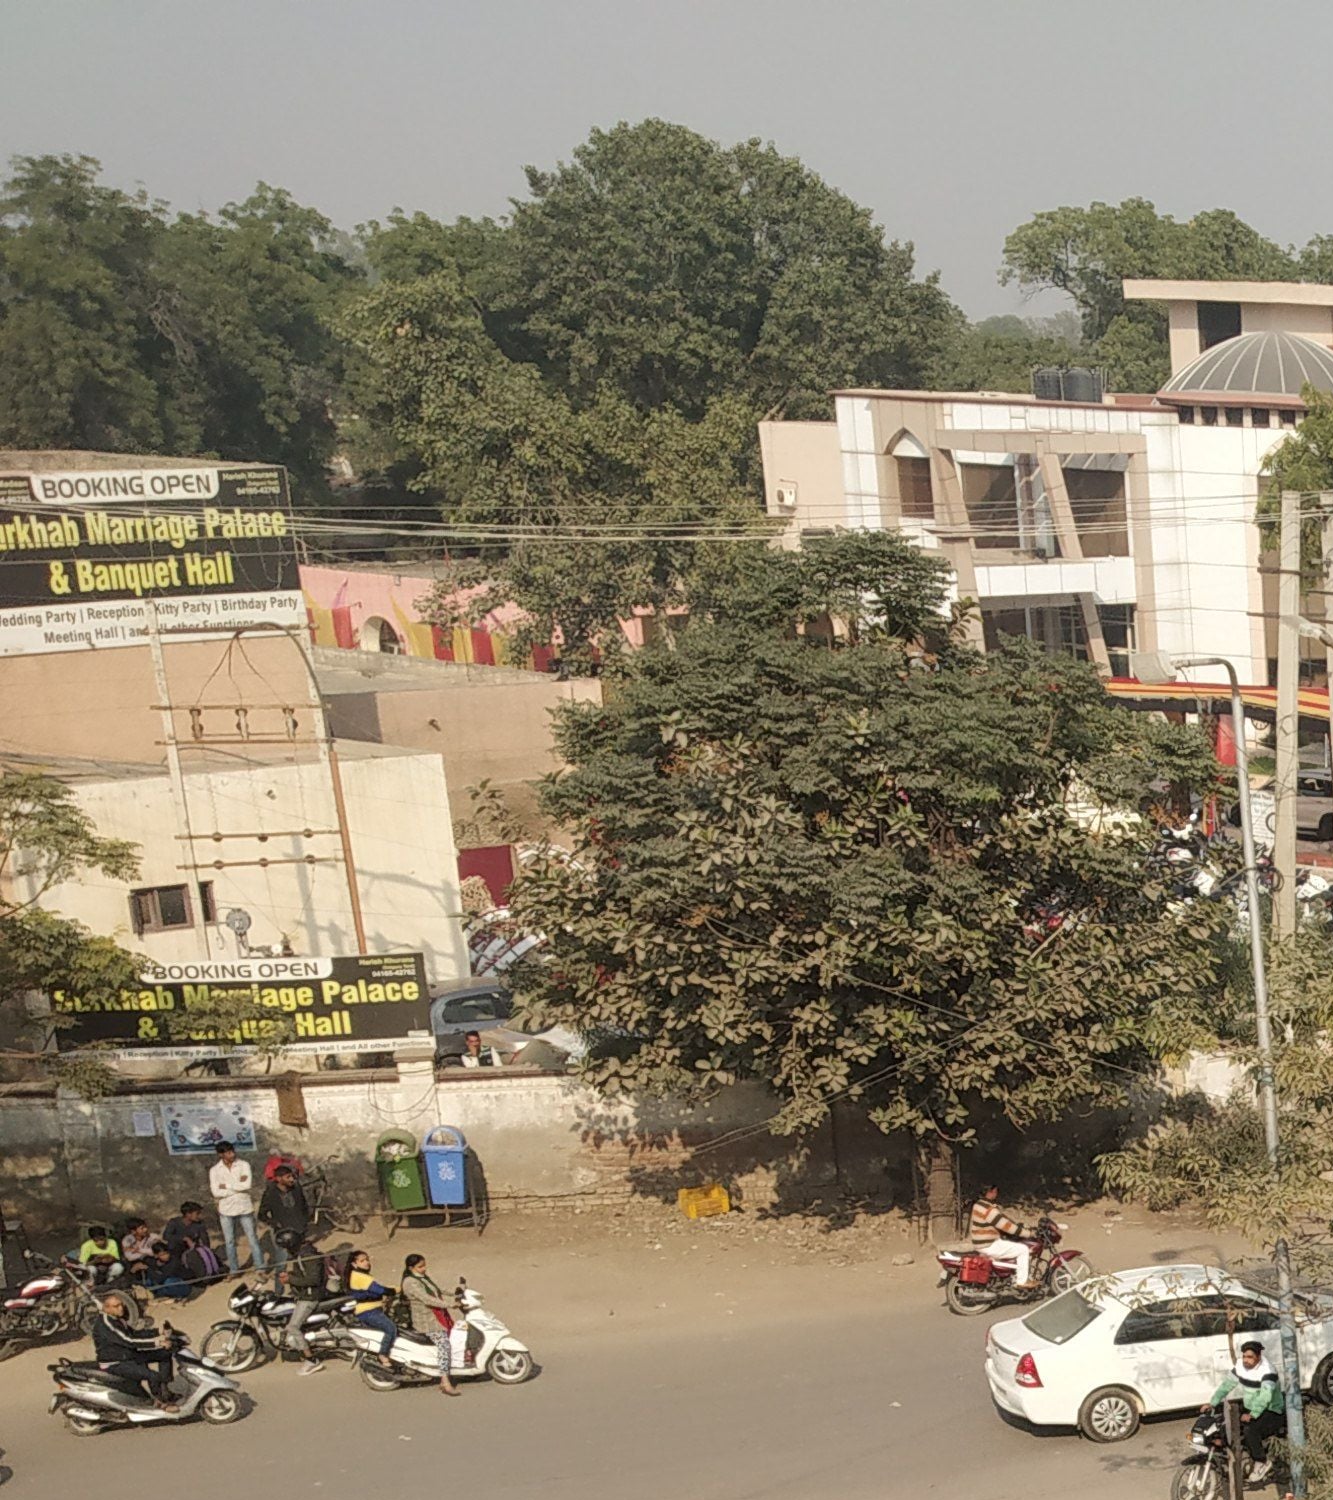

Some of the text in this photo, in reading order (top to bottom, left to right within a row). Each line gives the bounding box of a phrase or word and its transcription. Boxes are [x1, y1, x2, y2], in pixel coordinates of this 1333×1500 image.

[41, 476, 144, 499] BOOKING
[150, 474, 213, 495] OPEN
[84, 509, 200, 549] Marriage
[204, 507, 287, 539] Palace
[50, 551, 235, 597] & Banquet Hall
[46, 606, 76, 626] Party
[87, 603, 145, 623] Reception
[182, 599, 212, 617] Party
[222, 597, 268, 614] Birthday
[270, 595, 298, 612] Party
[44, 627, 94, 649] Meeting
[95, 626, 118, 641] Hall
[153, 960, 320, 981] BOOKING OPEN
[321, 978, 420, 1007] Palace
[138, 1017, 159, 1040] &
[295, 1011, 352, 1037] Hall
